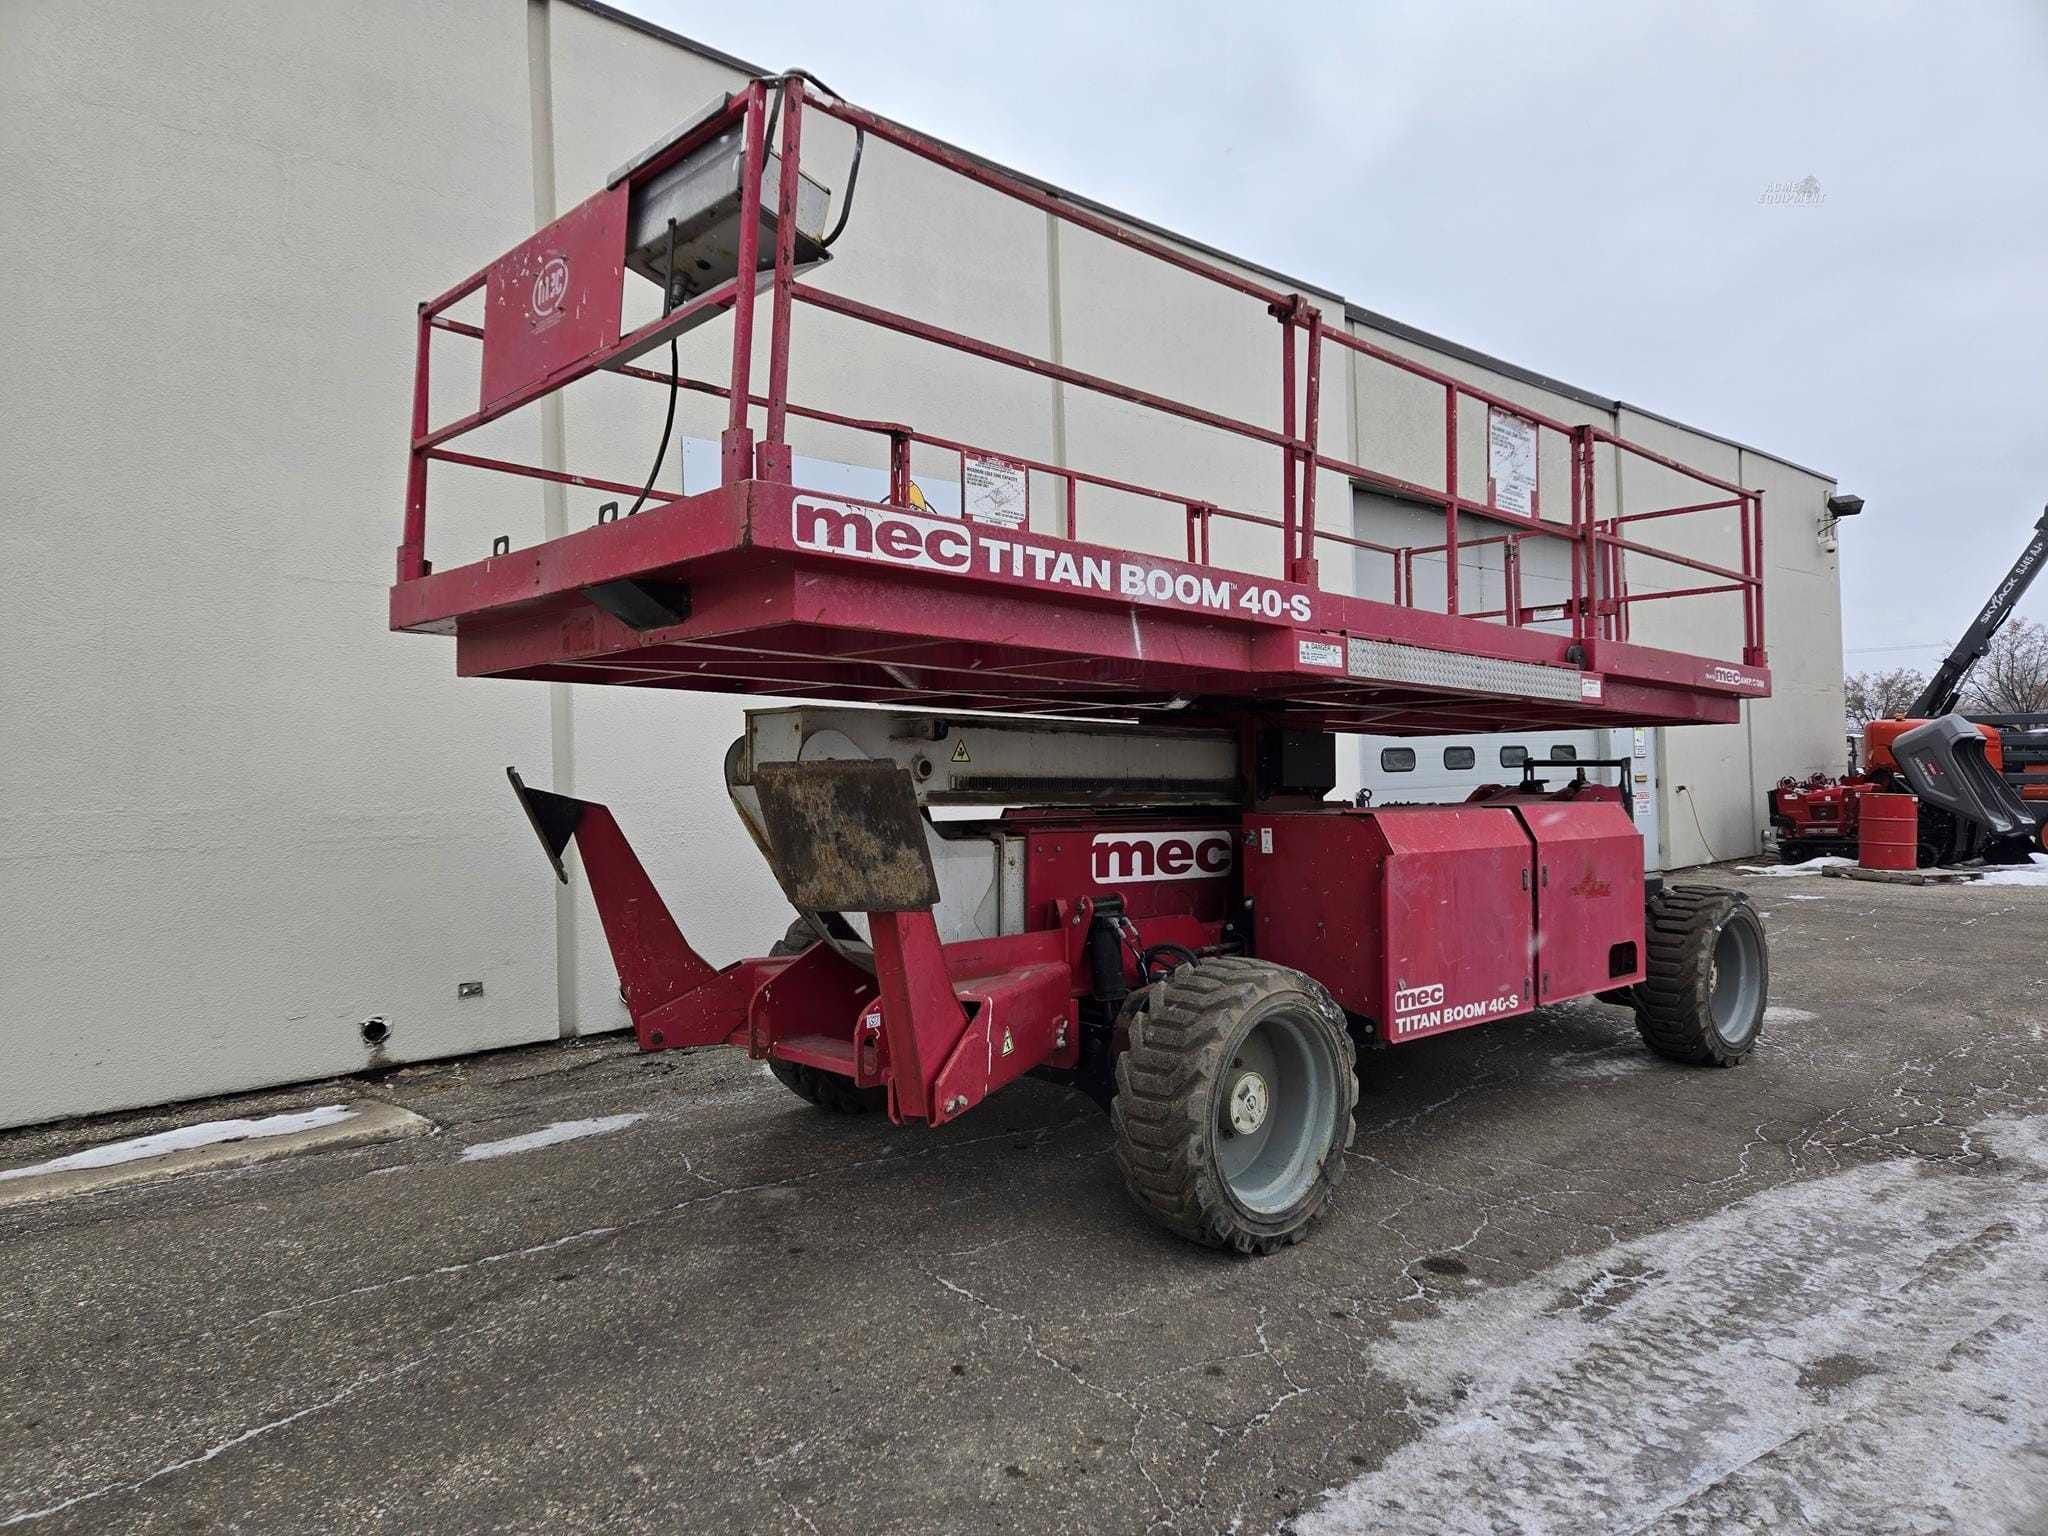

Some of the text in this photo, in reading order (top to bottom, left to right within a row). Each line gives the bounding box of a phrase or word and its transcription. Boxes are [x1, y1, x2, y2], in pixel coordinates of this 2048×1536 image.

[797, 503, 970, 567] mec
[979, 537, 1111, 591] TITAN
[1239, 586, 1312, 622] 40-S
[1980, 577, 2019, 624] SKYJACK
[1093, 838, 1232, 878] mec
[1395, 1010, 1441, 1034] TITAN
[1489, 994, 1519, 1013] 40-S
[1396, 986, 1443, 1010] mec
